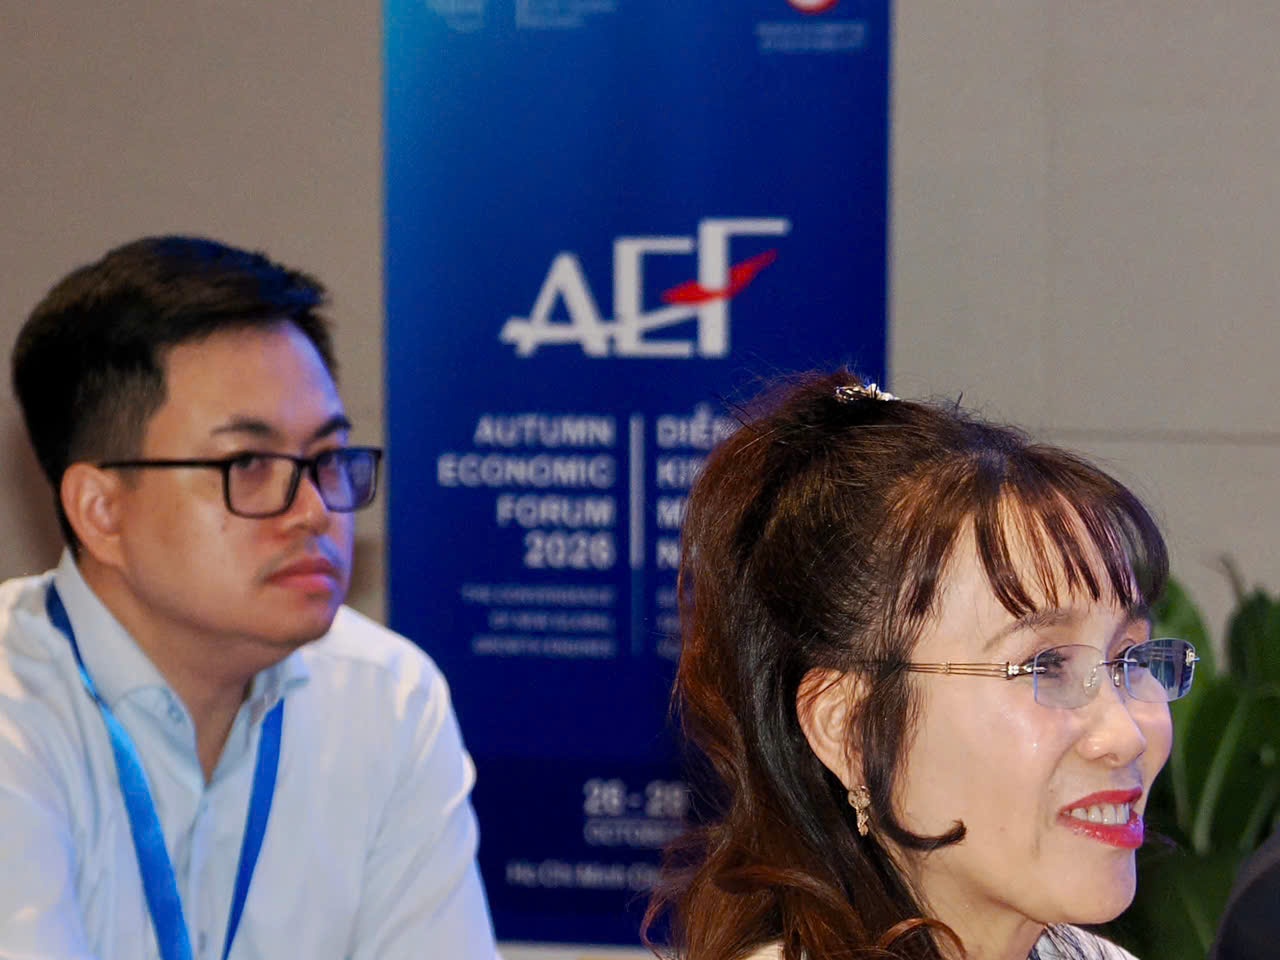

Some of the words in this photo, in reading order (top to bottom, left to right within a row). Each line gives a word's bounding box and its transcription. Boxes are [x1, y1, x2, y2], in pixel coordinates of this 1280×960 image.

[500, 218, 790, 357] AEF
[474, 416, 615, 446] AUTUMN
[437, 454, 615, 487] ECONOMIC
[497, 495, 615, 527] FORUM
[524, 532, 615, 568] 2026
